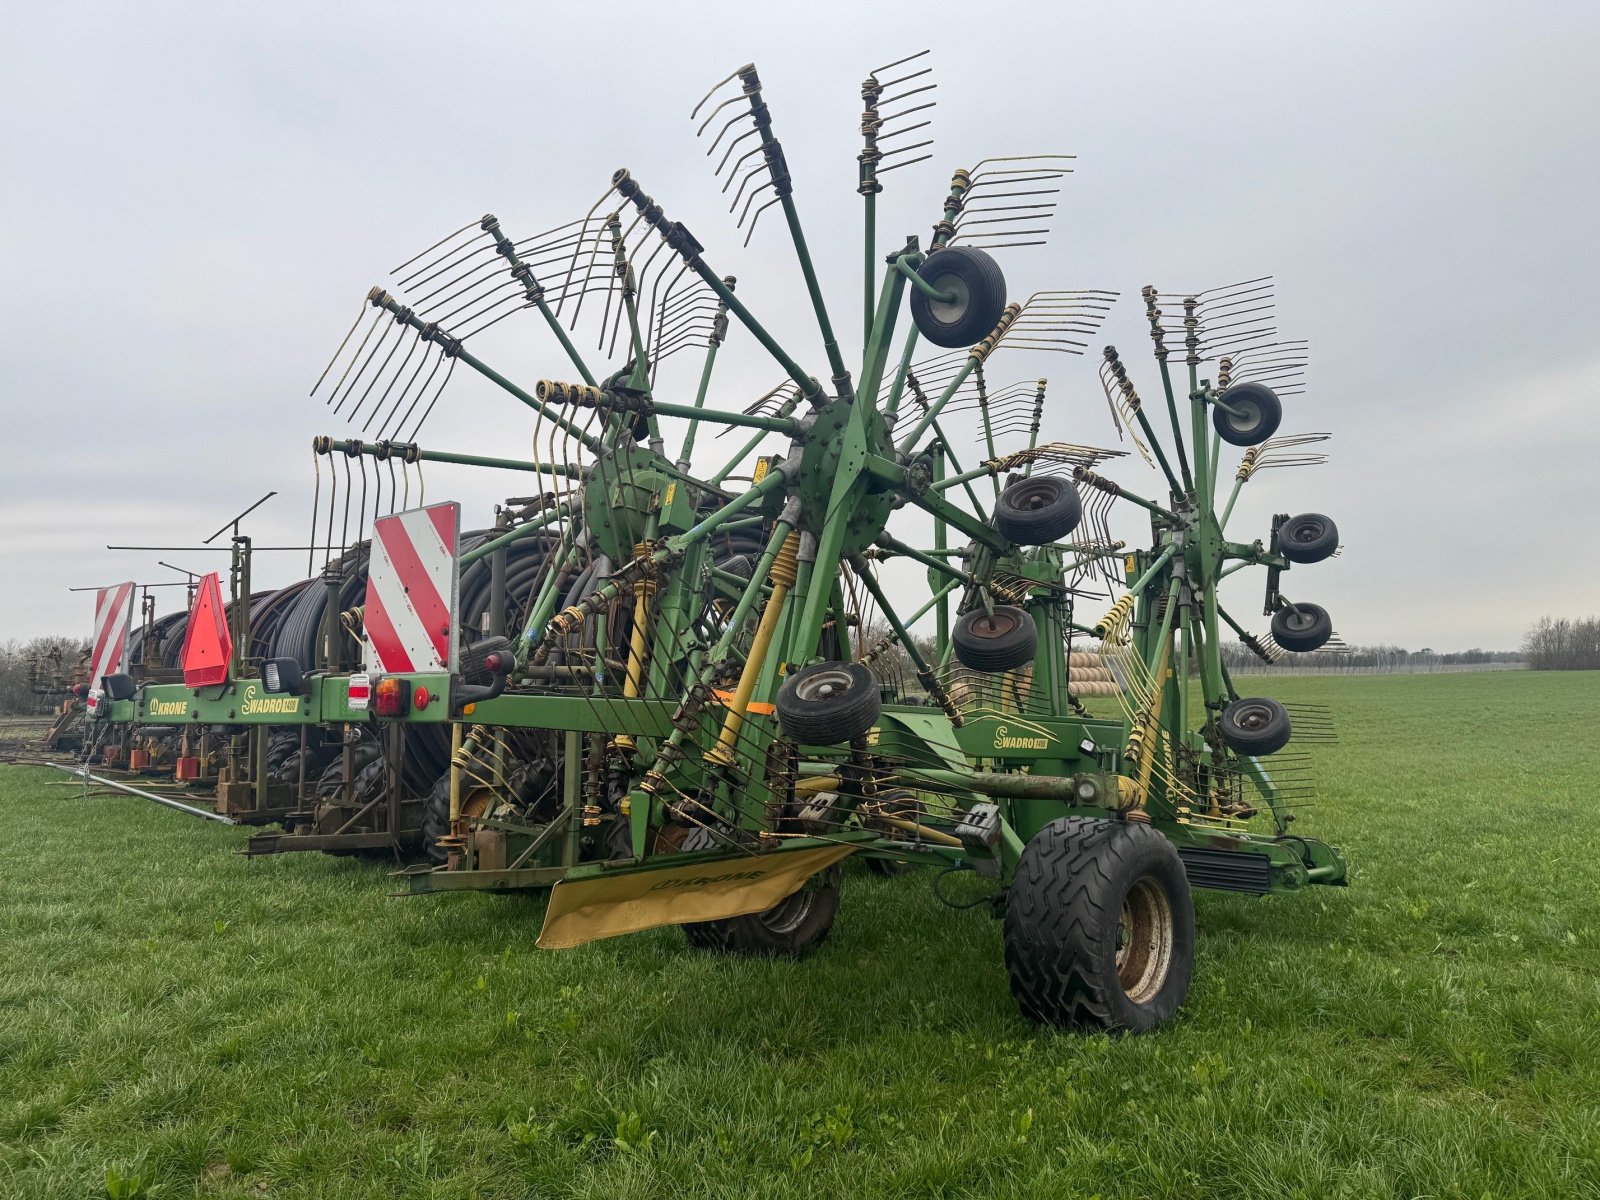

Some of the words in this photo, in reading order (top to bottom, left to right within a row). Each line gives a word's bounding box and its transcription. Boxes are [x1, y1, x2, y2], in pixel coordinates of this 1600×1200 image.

[158, 702, 187, 715] KRONE
[242, 686, 283, 715] SWADRO
[994, 726, 1034, 748] SWADRO
